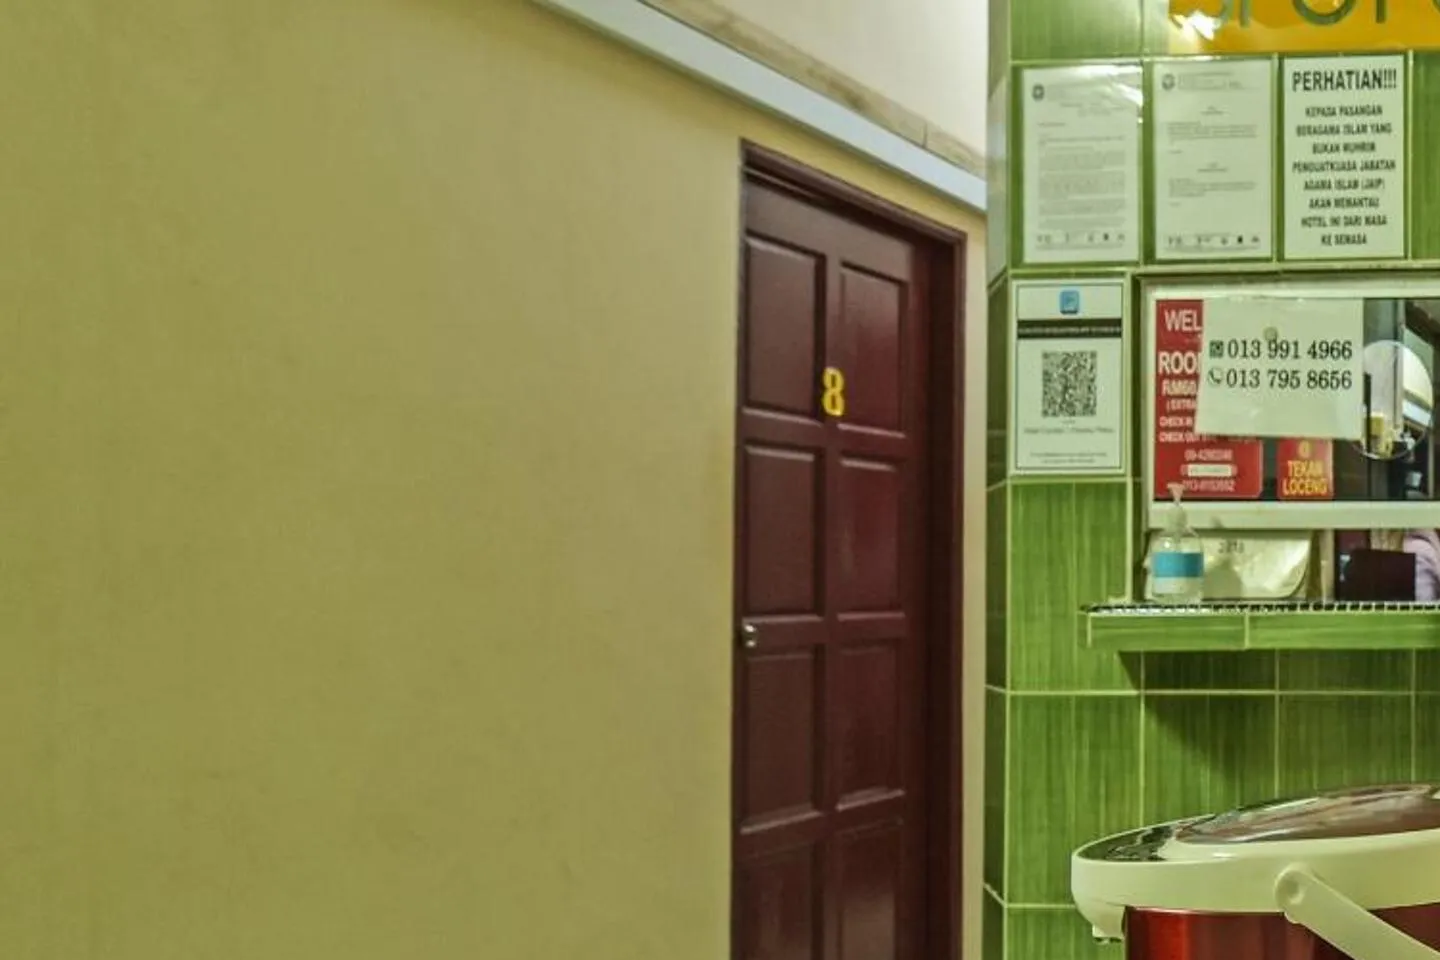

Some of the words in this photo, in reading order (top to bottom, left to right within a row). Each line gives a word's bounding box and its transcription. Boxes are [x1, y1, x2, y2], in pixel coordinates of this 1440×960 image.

[1292, 68, 1397, 92] PERHATIAN!!!
[1305, 106, 1337, 117] KEPADA
[1339, 104, 1383, 116] PASANGAN
[1296, 124, 1340, 137] BERAGAMA
[1342, 123, 1368, 135] ISLAM
[1369, 122, 1392, 134] YANG
[1312, 143, 1340, 154] BUKAN
[1359, 159, 1396, 171] JABATAN
[1304, 179, 1332, 190] AGAMA
[1334, 179, 1359, 190] ISLAM
[1309, 198, 1332, 209] AKAN
[1334, 197, 1379, 209] MEMANTAU
[1301, 216, 1328, 228] HOTEL
[1329, 216, 1341, 227] INI
[1343, 215, 1362, 226] DARI
[1364, 214, 1387, 226] MASA
[1321, 234, 1332, 246] KE
[1334, 233, 1367, 245] SEMASA
[1228, 338, 1261, 359] 013
[1267, 338, 1301, 359] 991
[1307, 339, 1352, 360] 4966
[1226, 368, 1260, 388] 013
[1267, 368, 1301, 389] 795
[1306, 368, 1352, 389] 8656
[823, 366, 844, 416] 8
[1287, 460, 1323, 477] TEKAN
[1283, 478, 1328, 497] LOCENG
